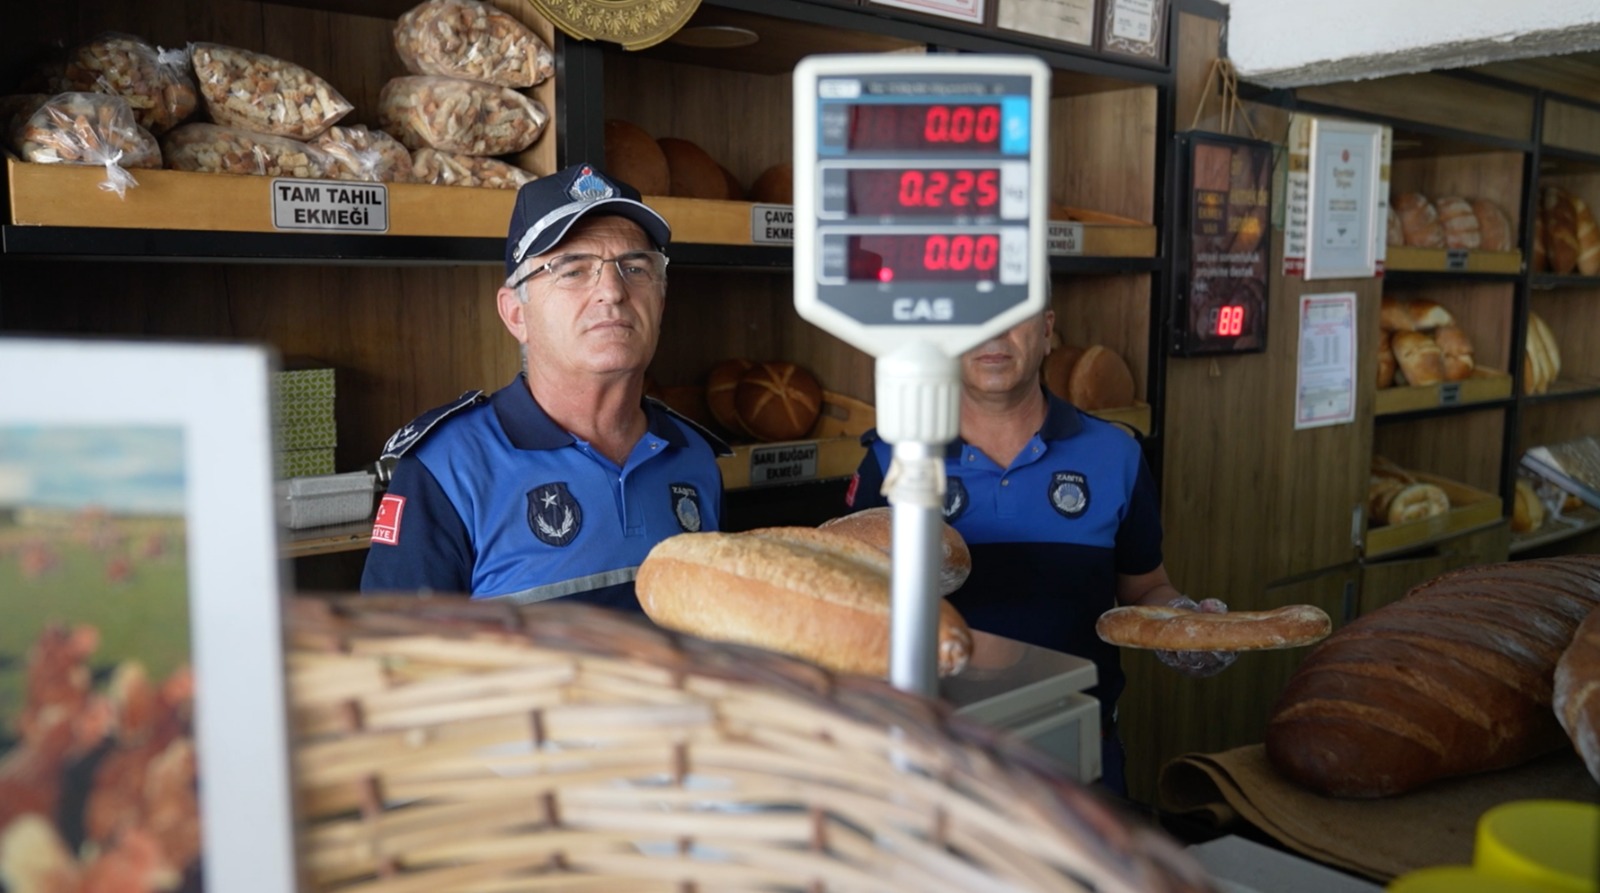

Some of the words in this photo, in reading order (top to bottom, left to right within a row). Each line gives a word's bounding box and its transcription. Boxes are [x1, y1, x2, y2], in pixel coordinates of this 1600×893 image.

[924, 106, 999, 143] 0.00
[279, 186, 320, 203] TAM
[326, 188, 382, 206] TAHIL
[898, 170, 998, 207] 0.225
[294, 207, 369, 226] EKMEĞİ
[923, 234, 998, 271] 0.00
[892, 298, 954, 321] CAS
[1218, 305, 1244, 336] 88
